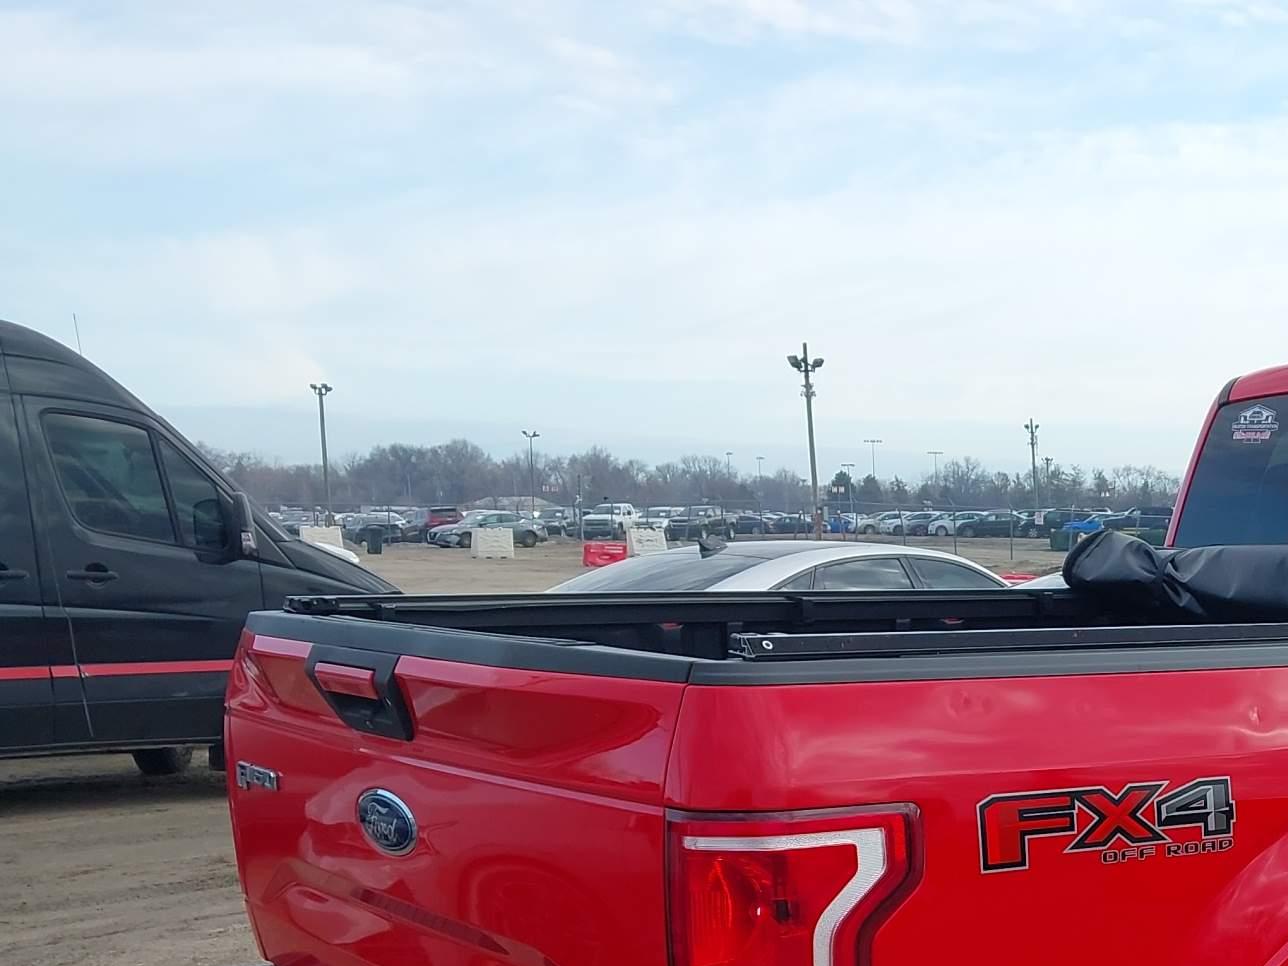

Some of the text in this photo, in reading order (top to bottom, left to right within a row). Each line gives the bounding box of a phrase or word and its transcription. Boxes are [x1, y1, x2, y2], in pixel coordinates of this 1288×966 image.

[976, 776, 1237, 874] FX4
[1101, 838, 1234, 864] OFF ROAD
